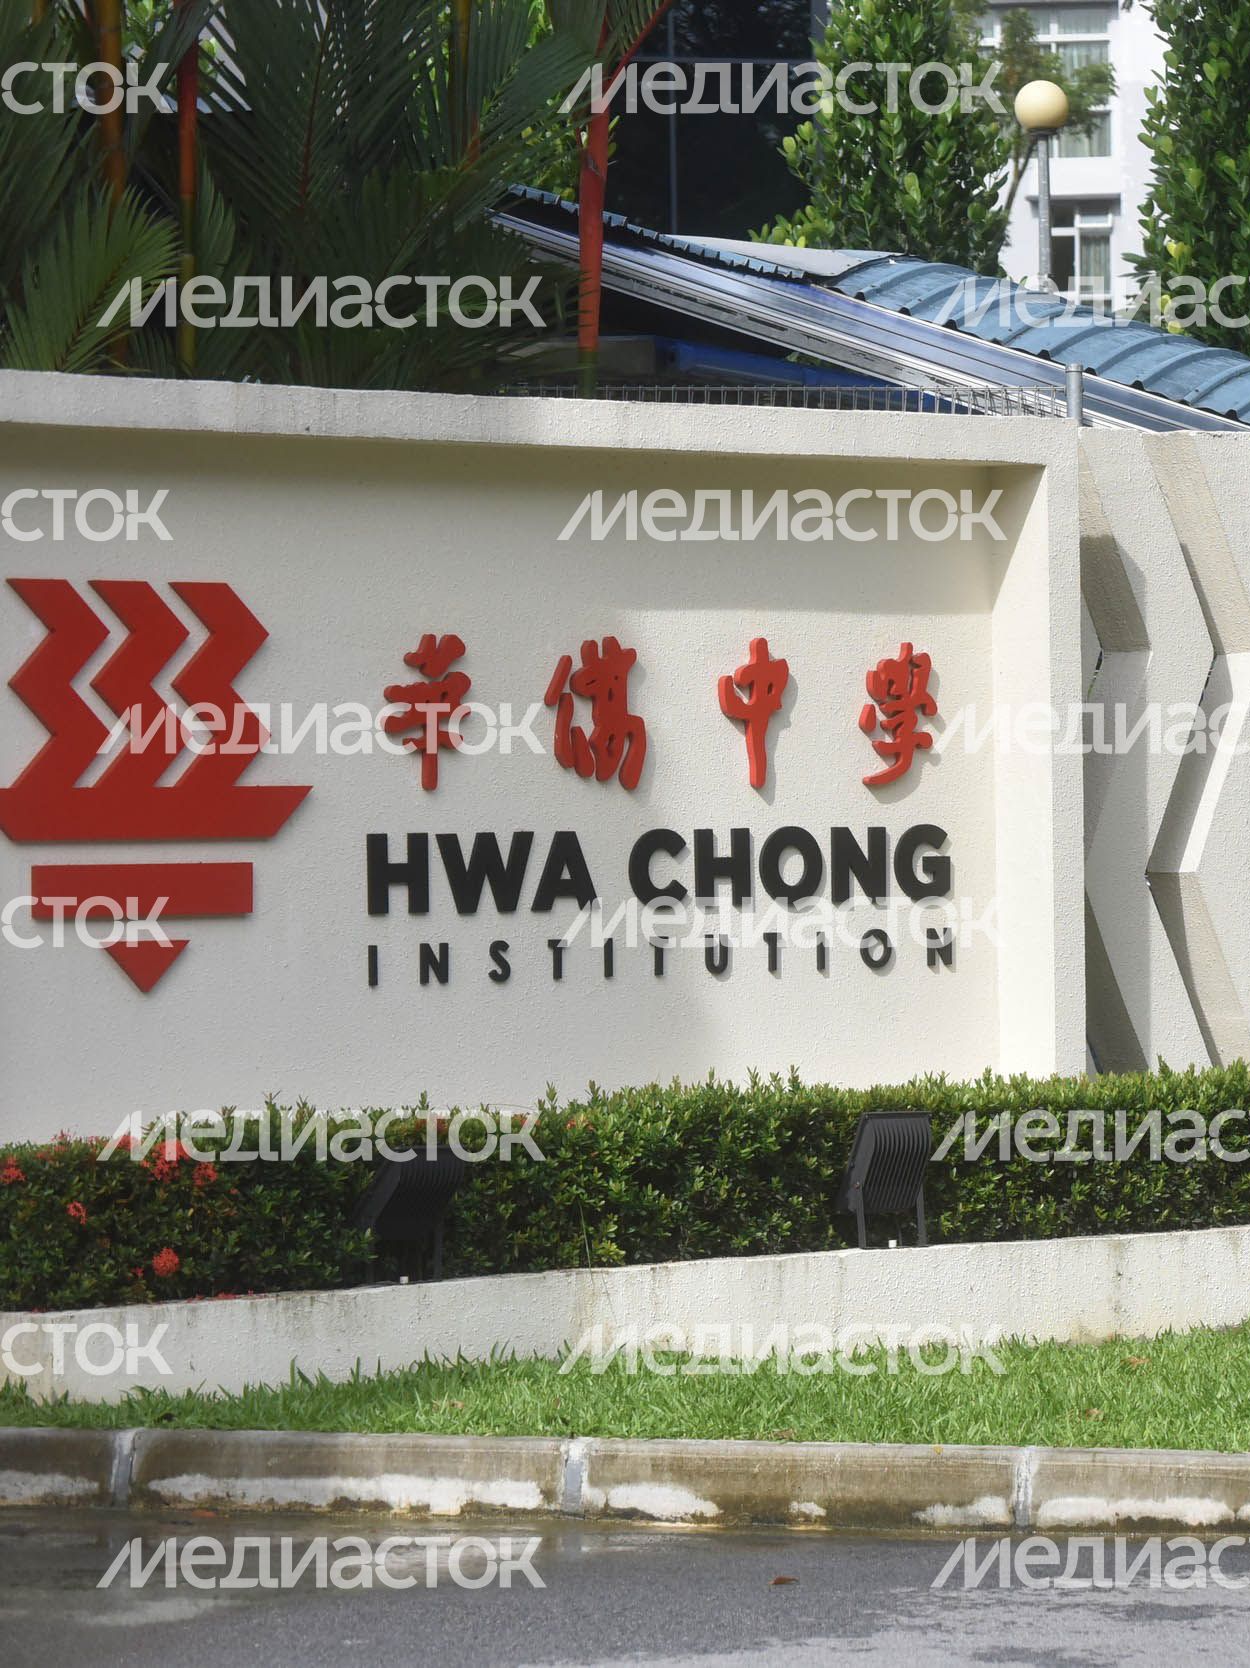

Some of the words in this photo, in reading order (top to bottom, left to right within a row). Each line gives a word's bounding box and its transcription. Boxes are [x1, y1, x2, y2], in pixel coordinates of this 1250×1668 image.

[366, 831, 601, 915] HWA
[628, 823, 951, 914] CHONG
[368, 928, 953, 986] INSTITUTION
